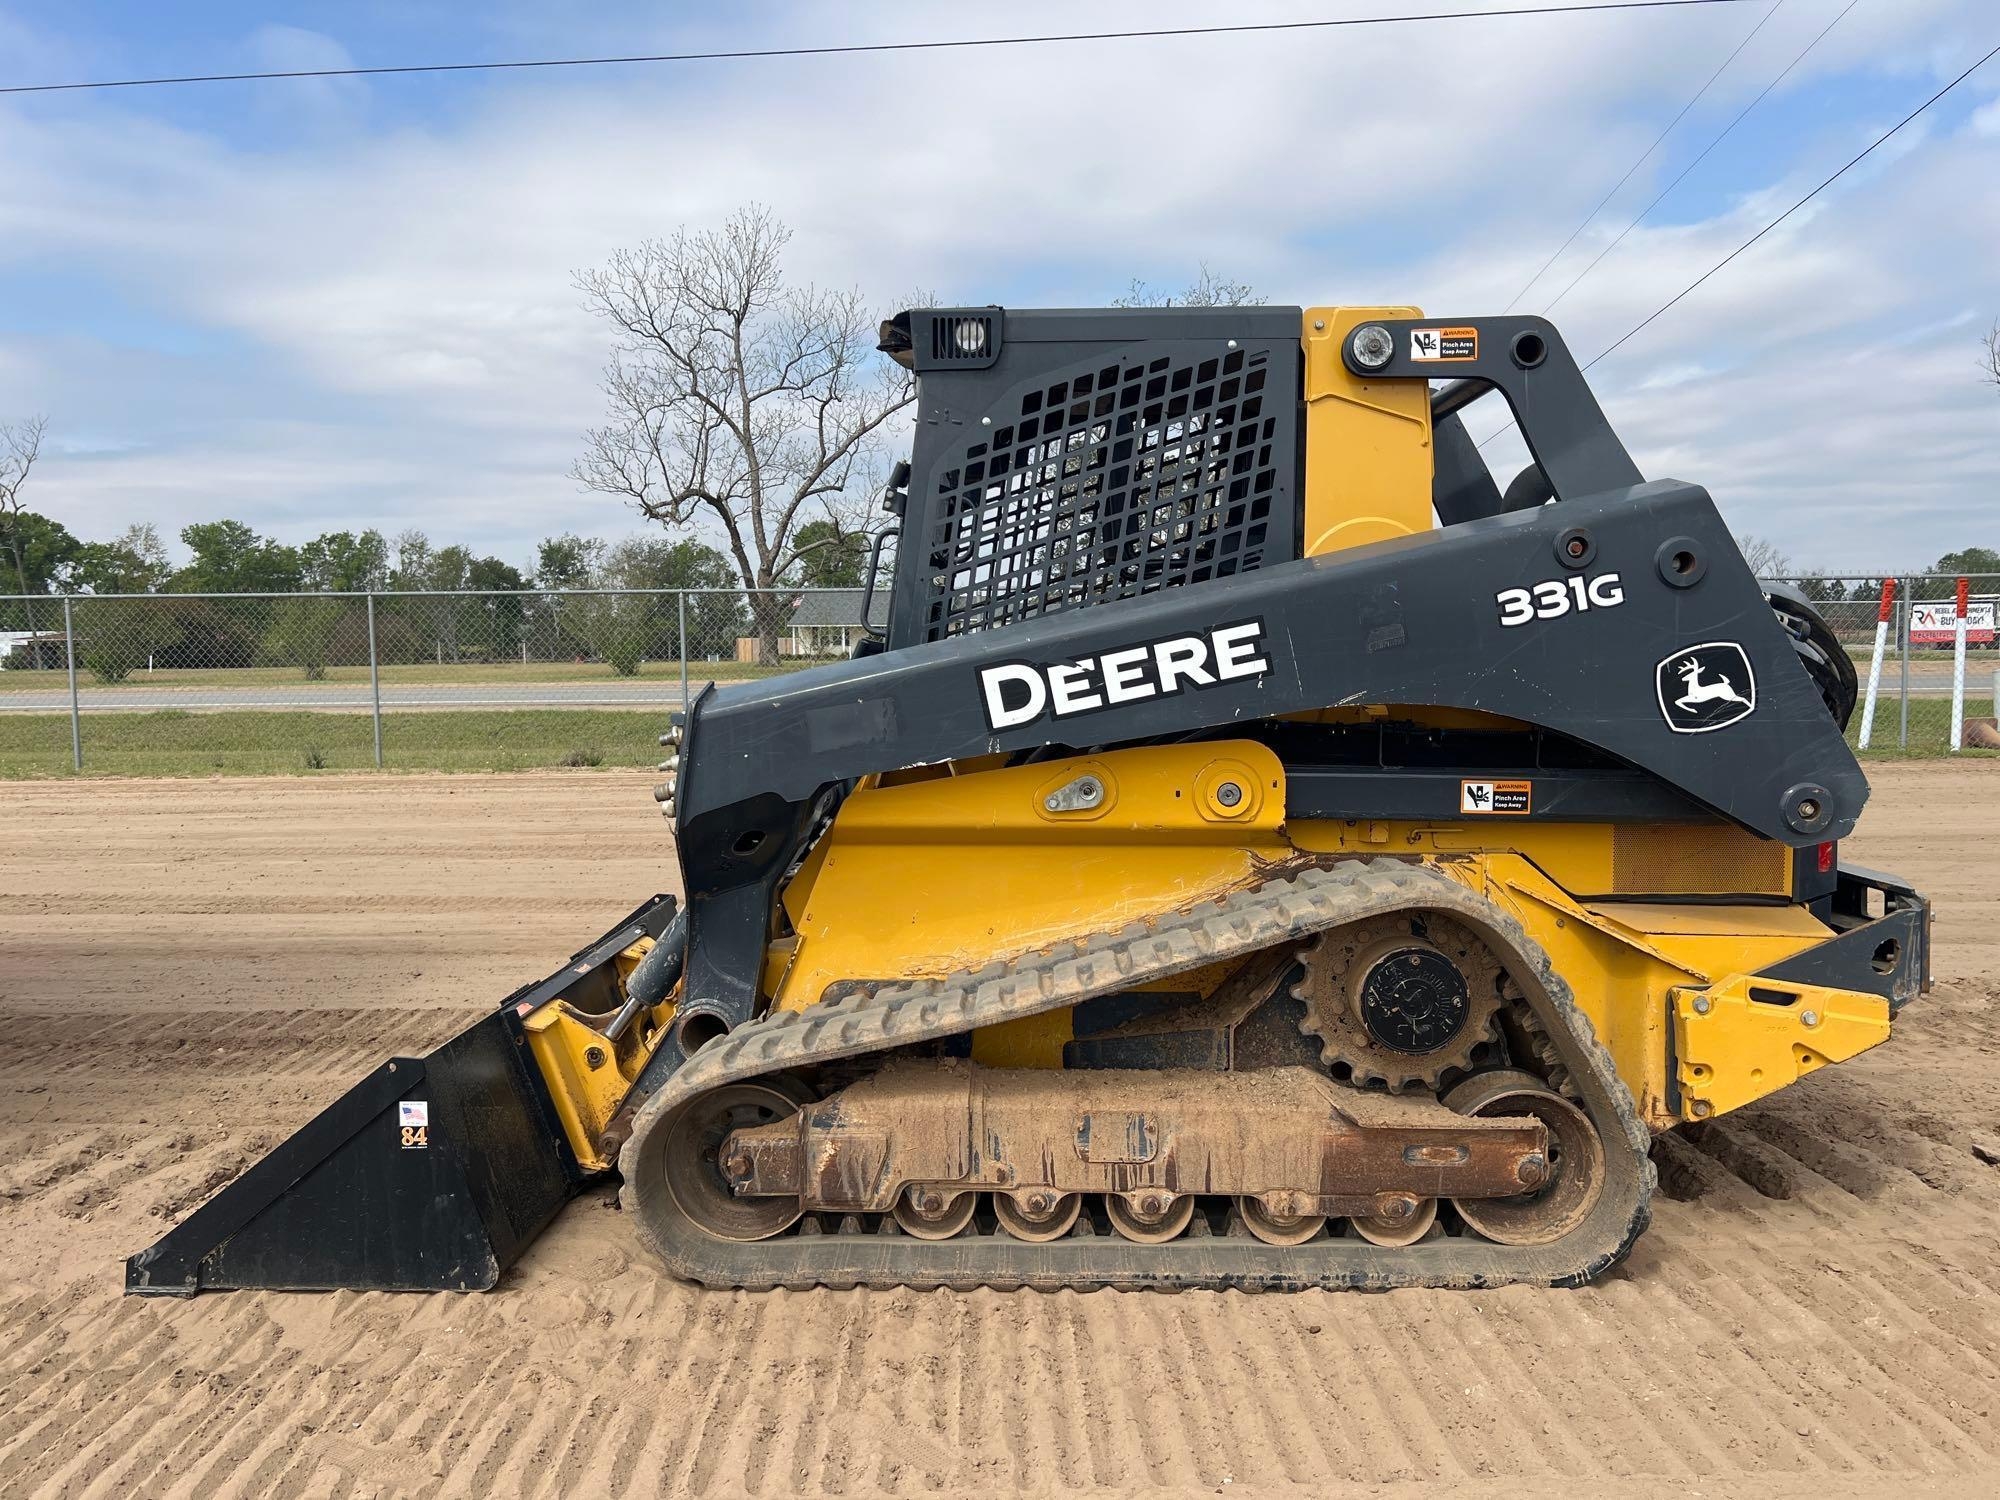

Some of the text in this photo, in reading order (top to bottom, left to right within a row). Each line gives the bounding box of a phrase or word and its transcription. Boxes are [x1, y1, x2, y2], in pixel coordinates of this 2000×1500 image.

[1496, 573, 1624, 626] 331G
[1940, 616, 1956, 625] BUY
[980, 622, 1268, 729] DEERE
